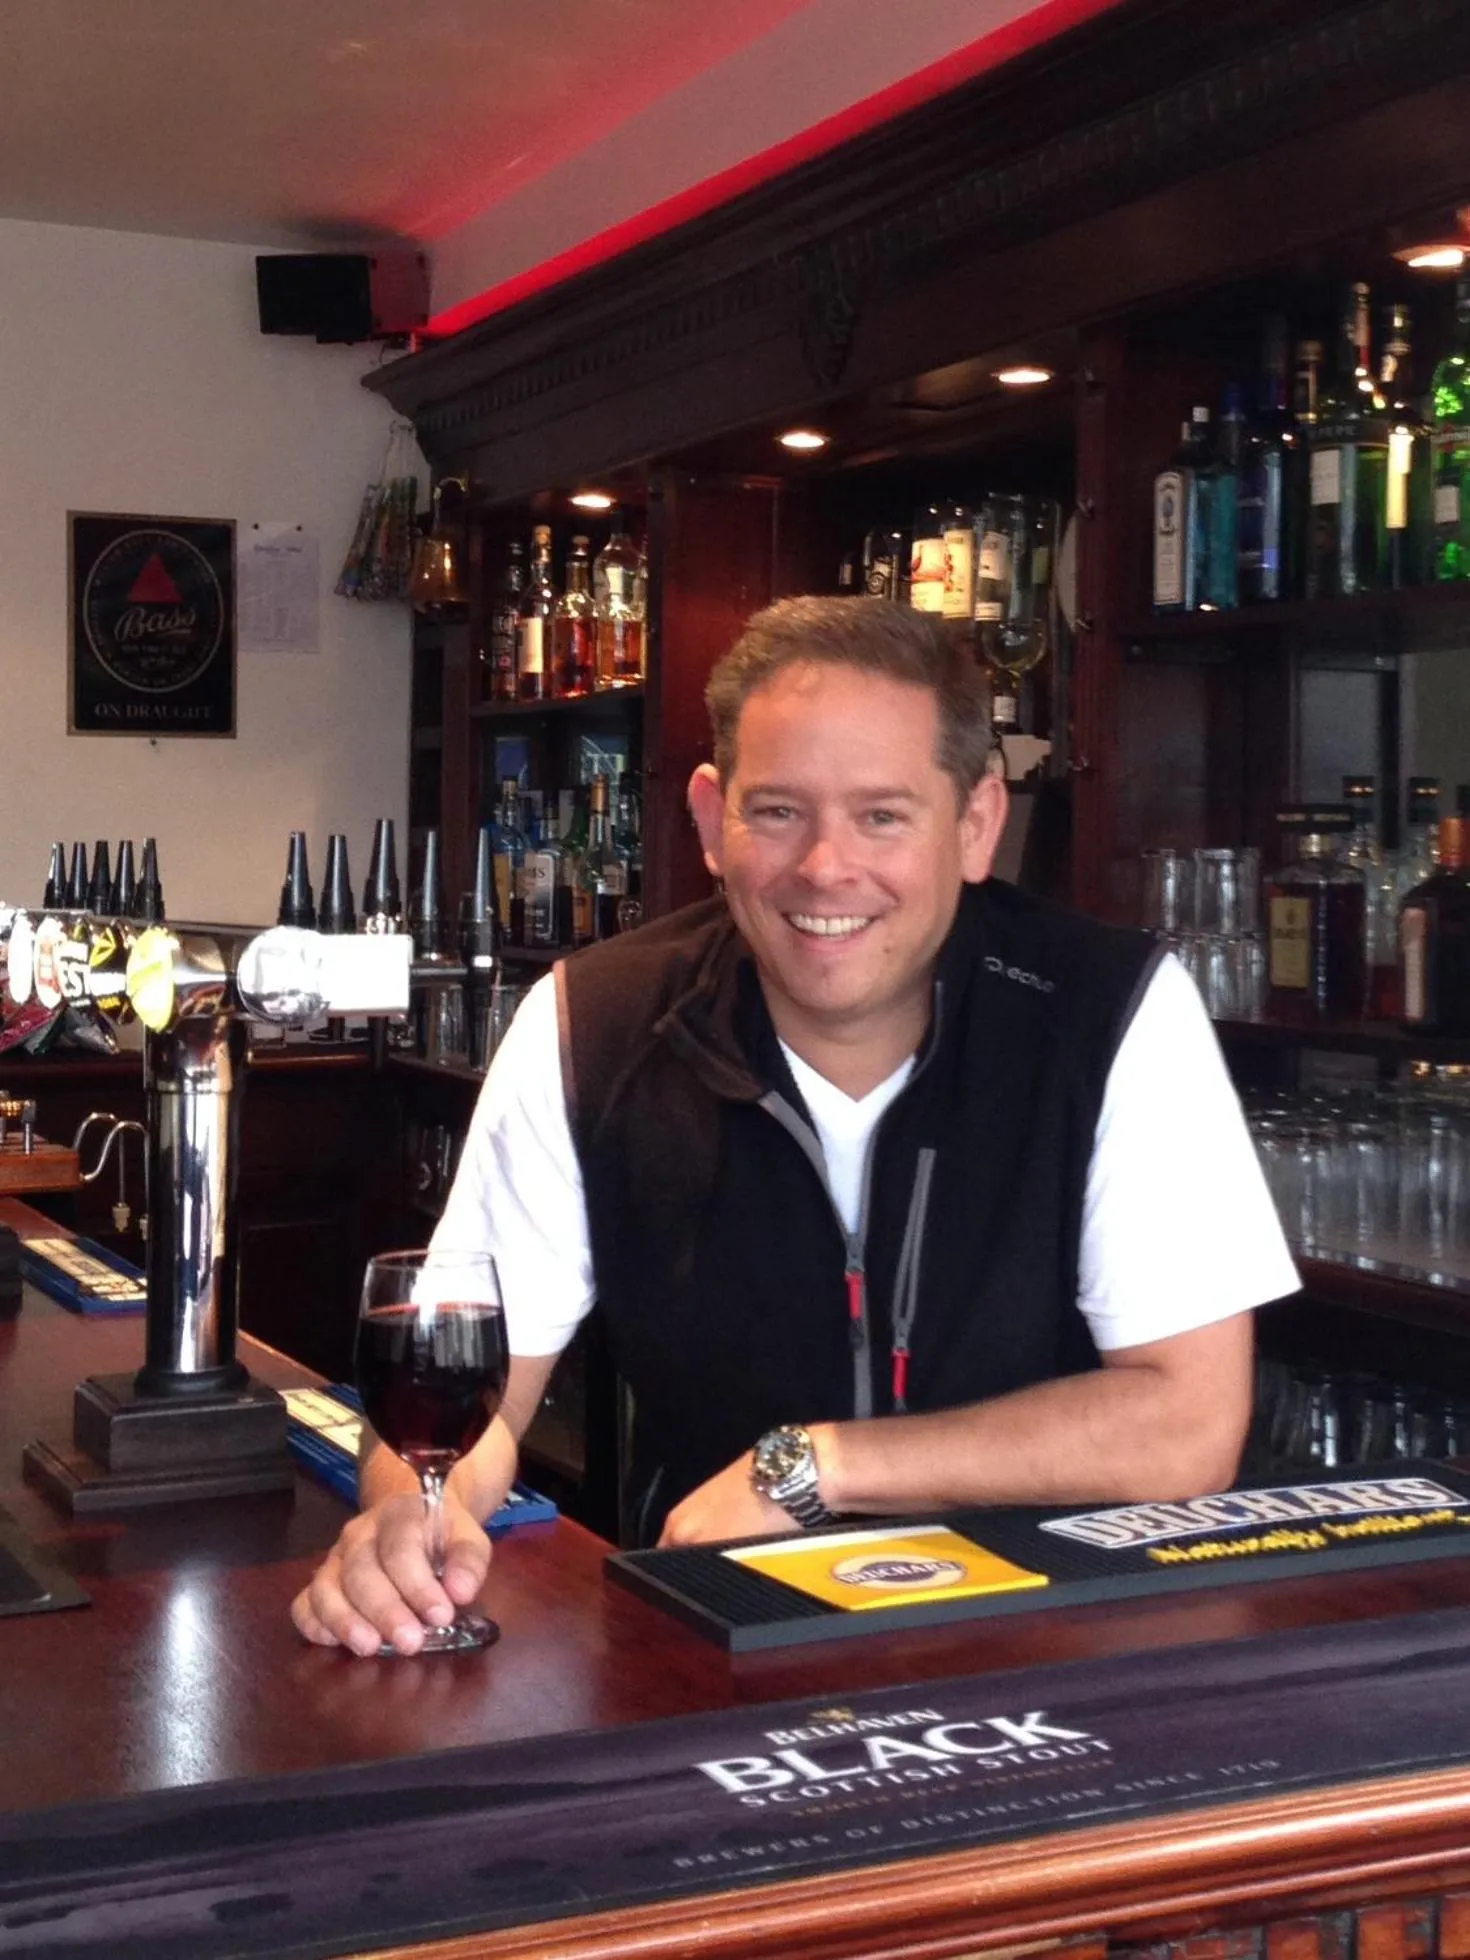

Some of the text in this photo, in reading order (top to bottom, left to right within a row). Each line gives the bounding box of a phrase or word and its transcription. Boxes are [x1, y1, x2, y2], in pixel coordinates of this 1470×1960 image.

[114, 606, 197, 642] Bass
[94, 702, 121, 718] ON
[1060, 1478, 1450, 1545] DEUCHARS
[693, 1710, 1092, 1793] BLACK
[764, 1707, 945, 1745] BELHAVEN
[740, 1738, 1113, 1809] SCOTTISH STOUT
[671, 1831, 831, 1869] BREWERS
[845, 1822, 884, 1840] OF
[903, 1787, 1105, 1831] DISTINCTION
[1114, 1771, 1204, 1793] SINCE
